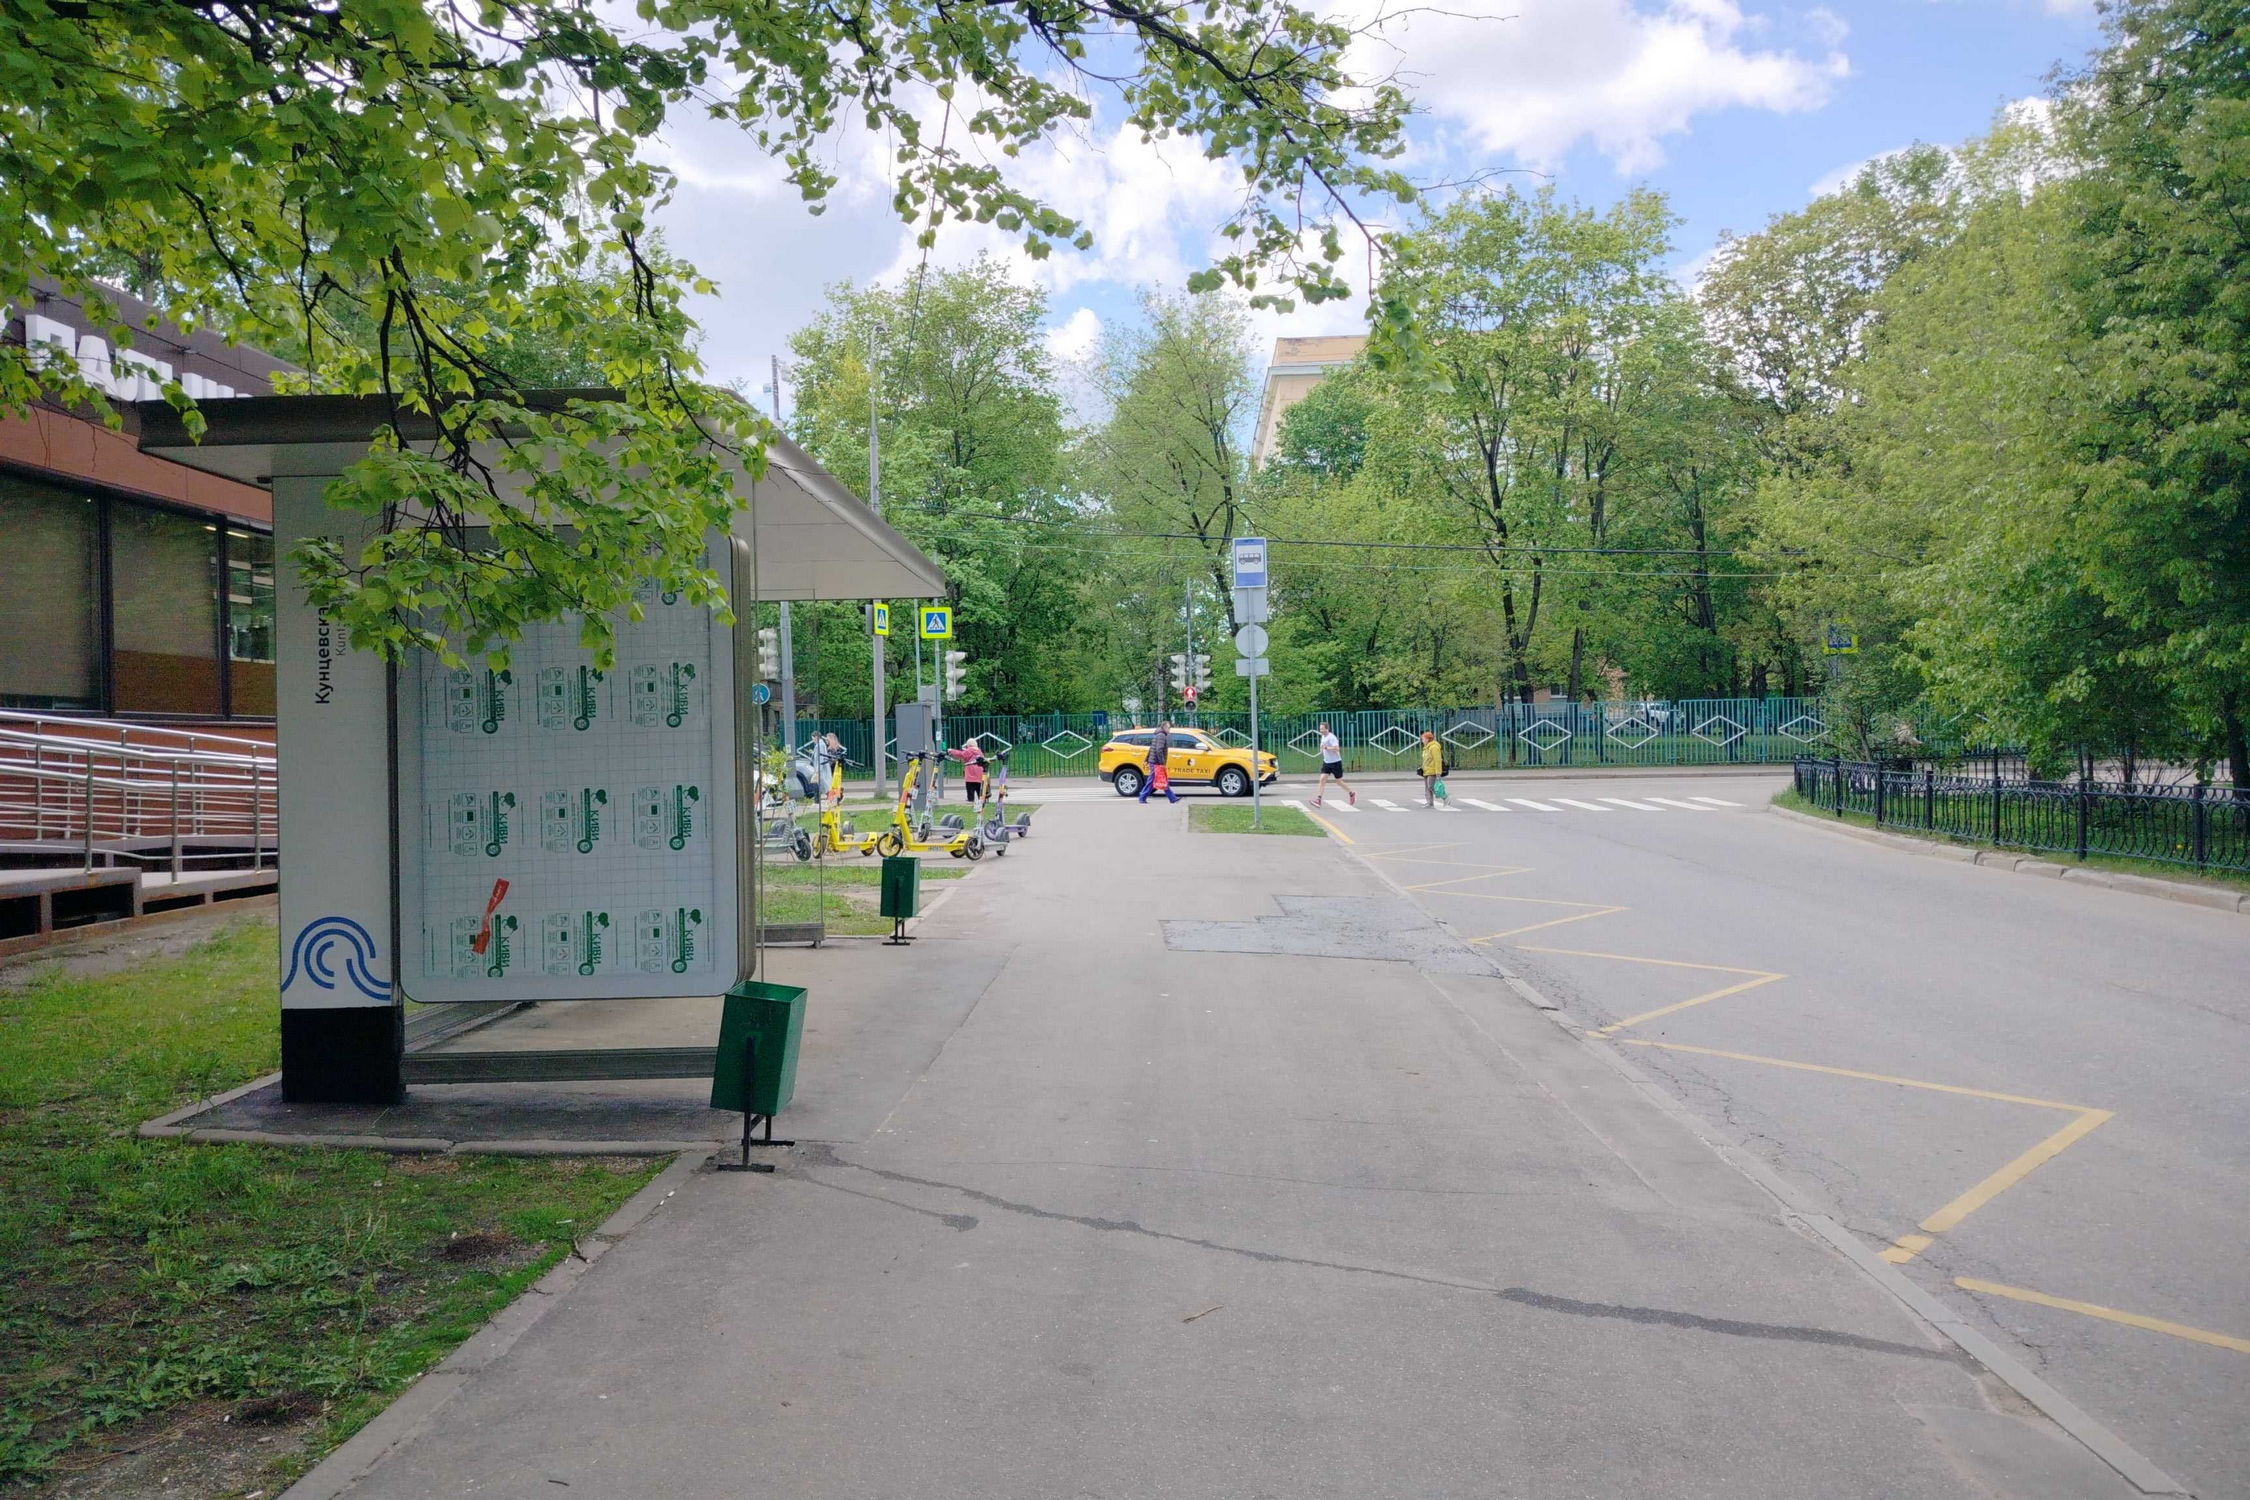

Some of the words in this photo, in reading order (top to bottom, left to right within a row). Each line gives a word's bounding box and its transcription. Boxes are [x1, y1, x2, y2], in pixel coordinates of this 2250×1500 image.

[315, 599, 333, 704] Кунцевска
[495, 689, 504, 722] КИВИ
[588, 686, 596, 719] КИВИ
[679, 684, 688, 715] КИВИ
[499, 813, 508, 844] КИВИ
[592, 810, 600, 841] КИВИ
[683, 806, 692, 837] КИВИ
[501, 937, 510, 968] КИВИ
[593, 933, 602, 966] КИВИ
[685, 929, 694, 961] КИВИ
